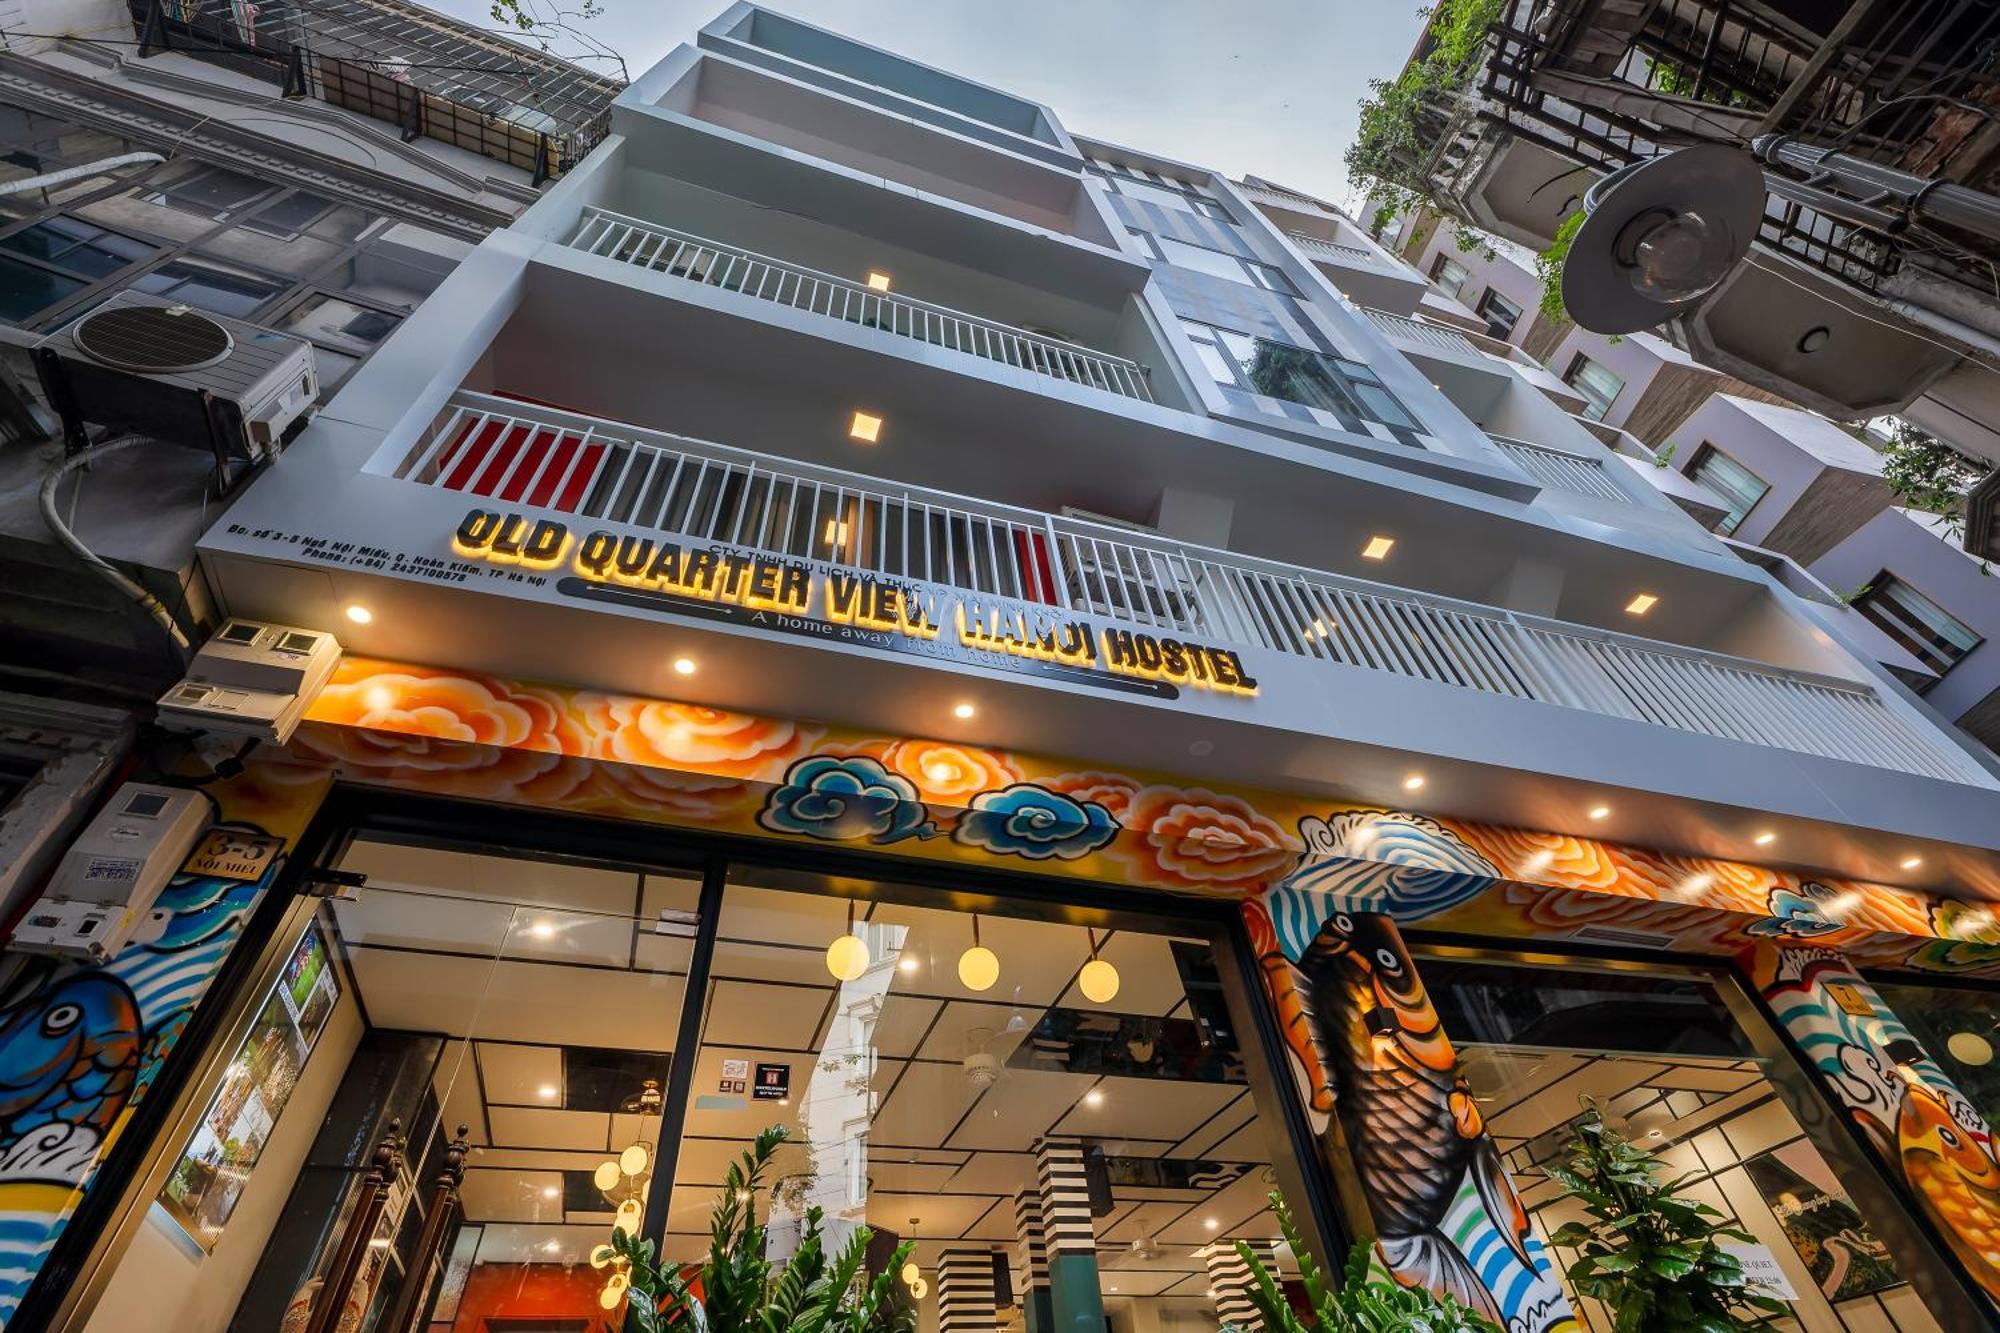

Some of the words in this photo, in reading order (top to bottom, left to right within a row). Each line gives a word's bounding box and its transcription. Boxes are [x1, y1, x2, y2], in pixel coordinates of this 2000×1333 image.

[301, 547, 347, 564] Phone:
[455, 508, 570, 562] OLD
[578, 530, 812, 610] QUARTER
[827, 573, 942, 634] VIEW
[1104, 627, 1259, 692] HOSTEL
[751, 610, 768, 624] A
[777, 614, 833, 634] home
[841, 627, 894, 648] away
